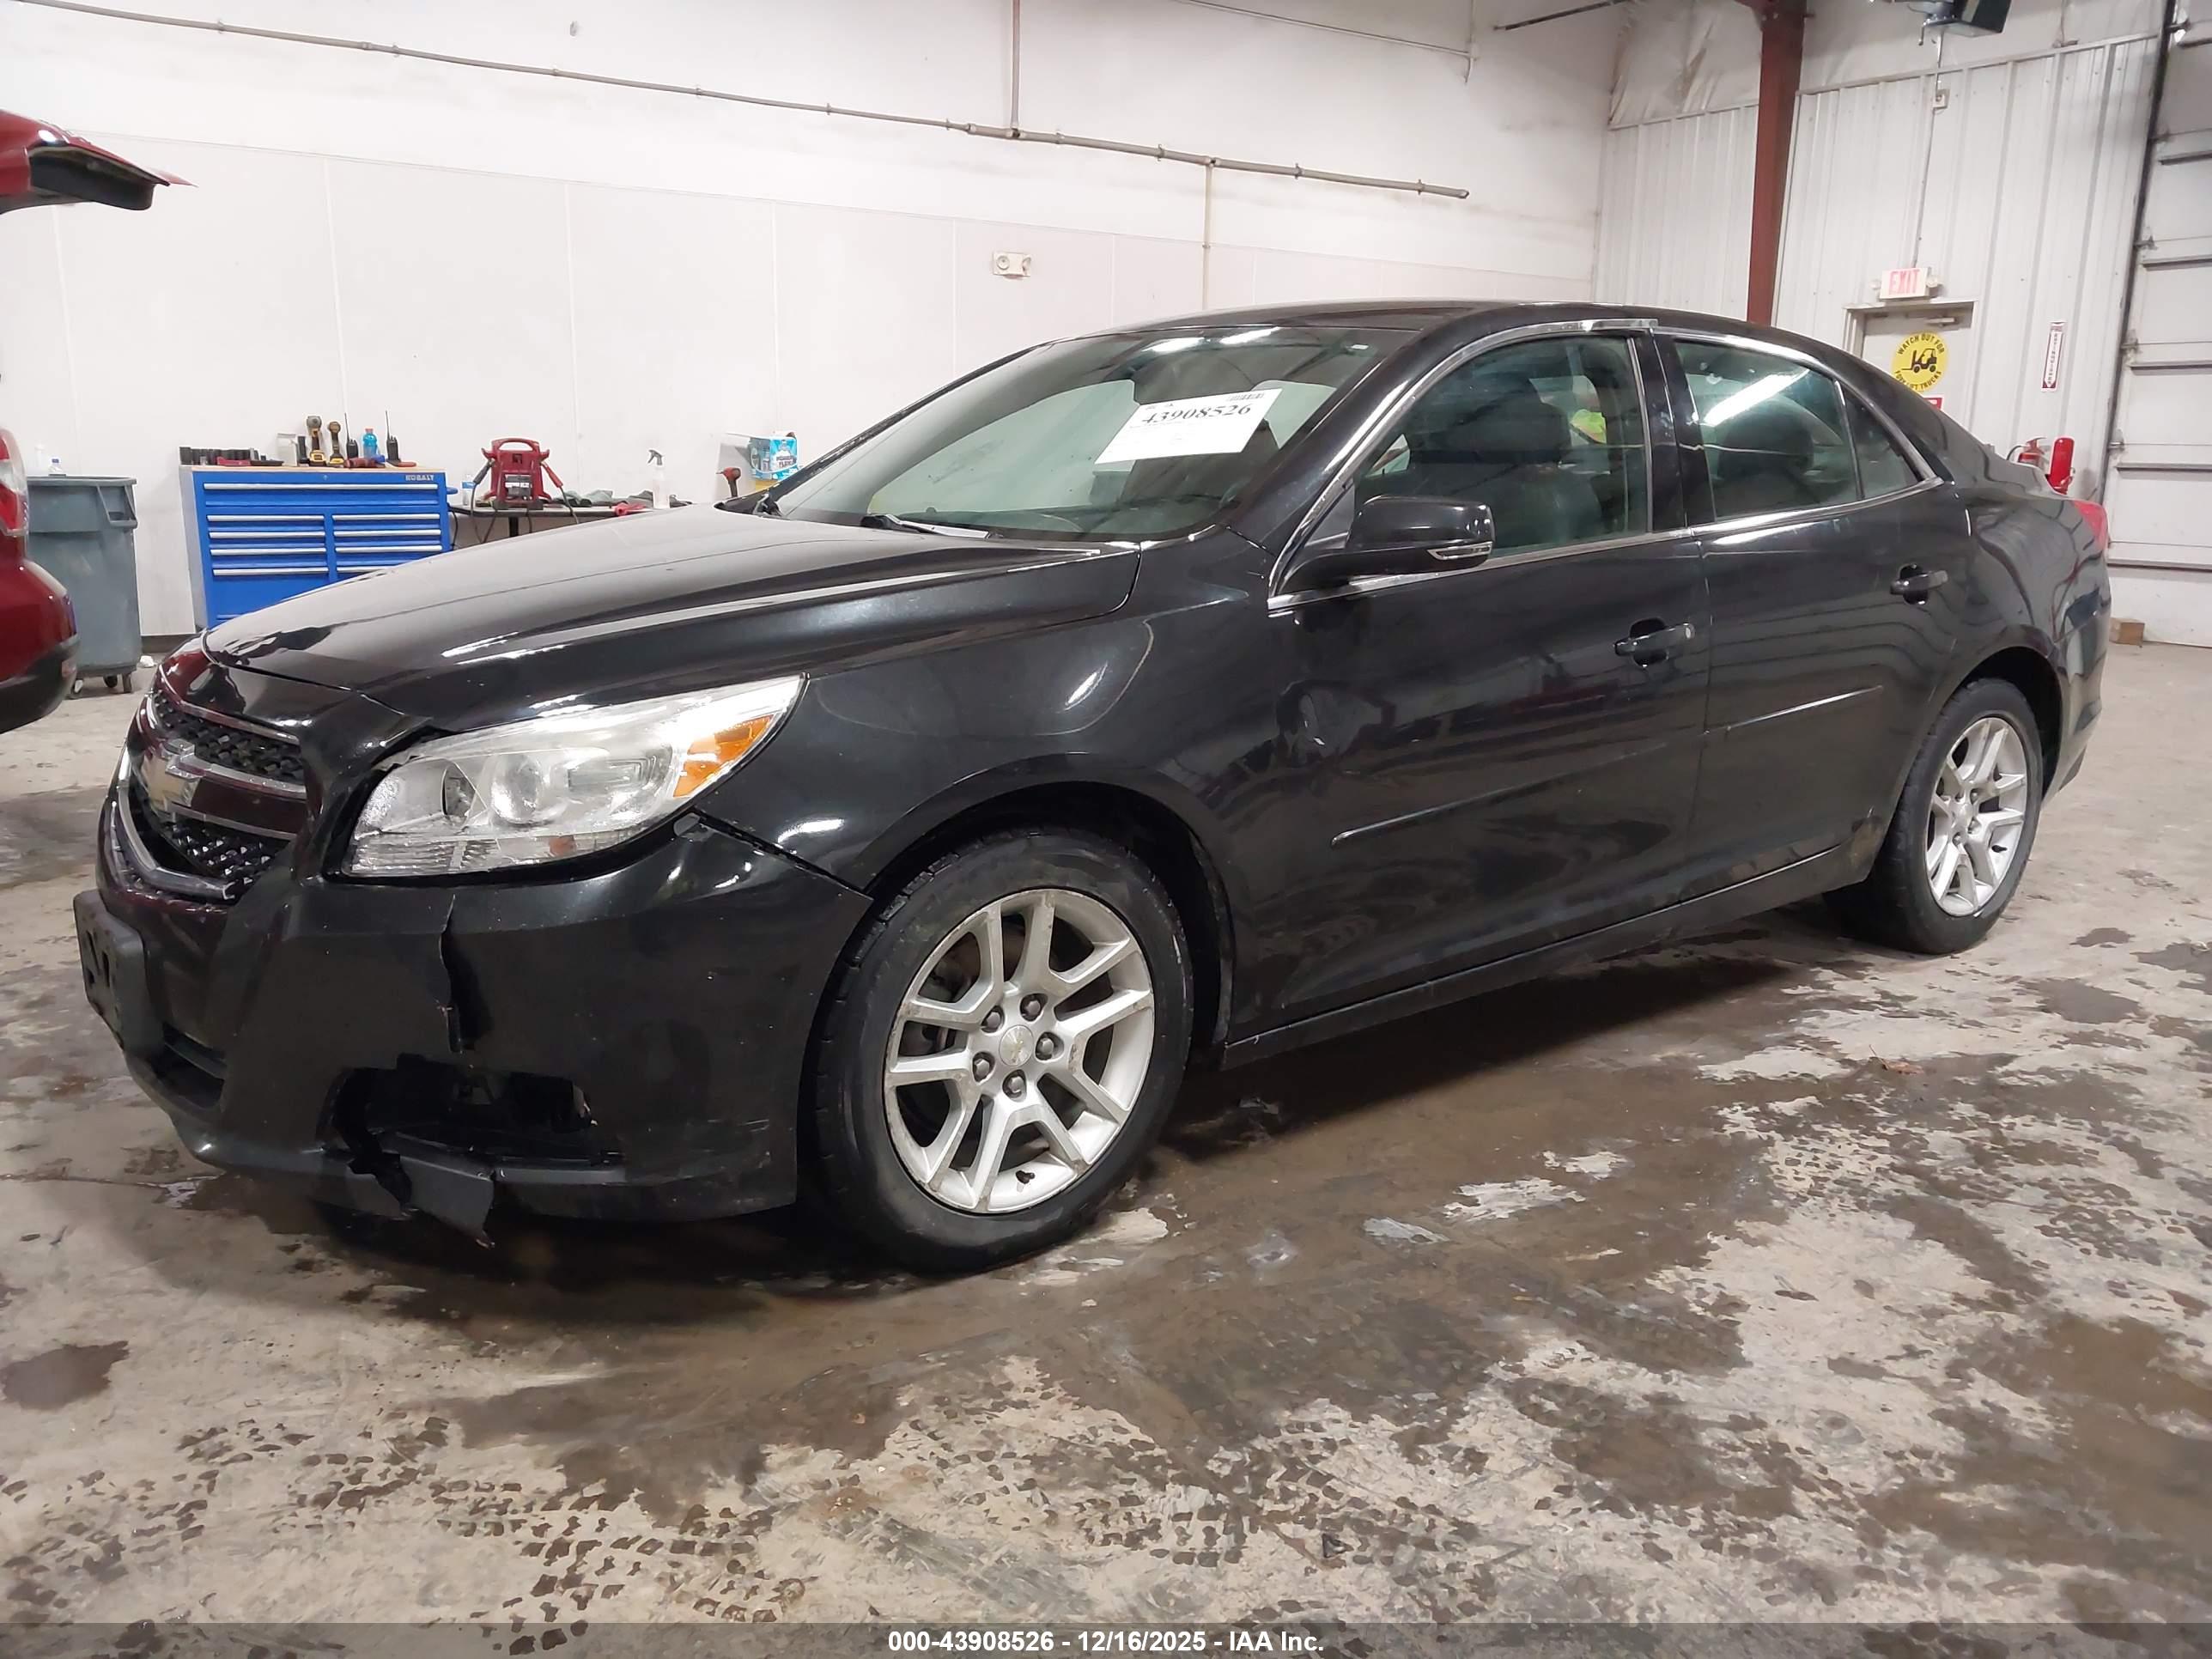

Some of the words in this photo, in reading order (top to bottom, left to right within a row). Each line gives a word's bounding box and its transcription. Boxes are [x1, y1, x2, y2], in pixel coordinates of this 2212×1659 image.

[1888, 269, 1919, 295] EXIT
[1898, 336, 1919, 355] WATCH
[1921, 333, 1936, 343] OUT
[1934, 339, 1945, 354] FOR
[1142, 404, 1251, 423] 43908526
